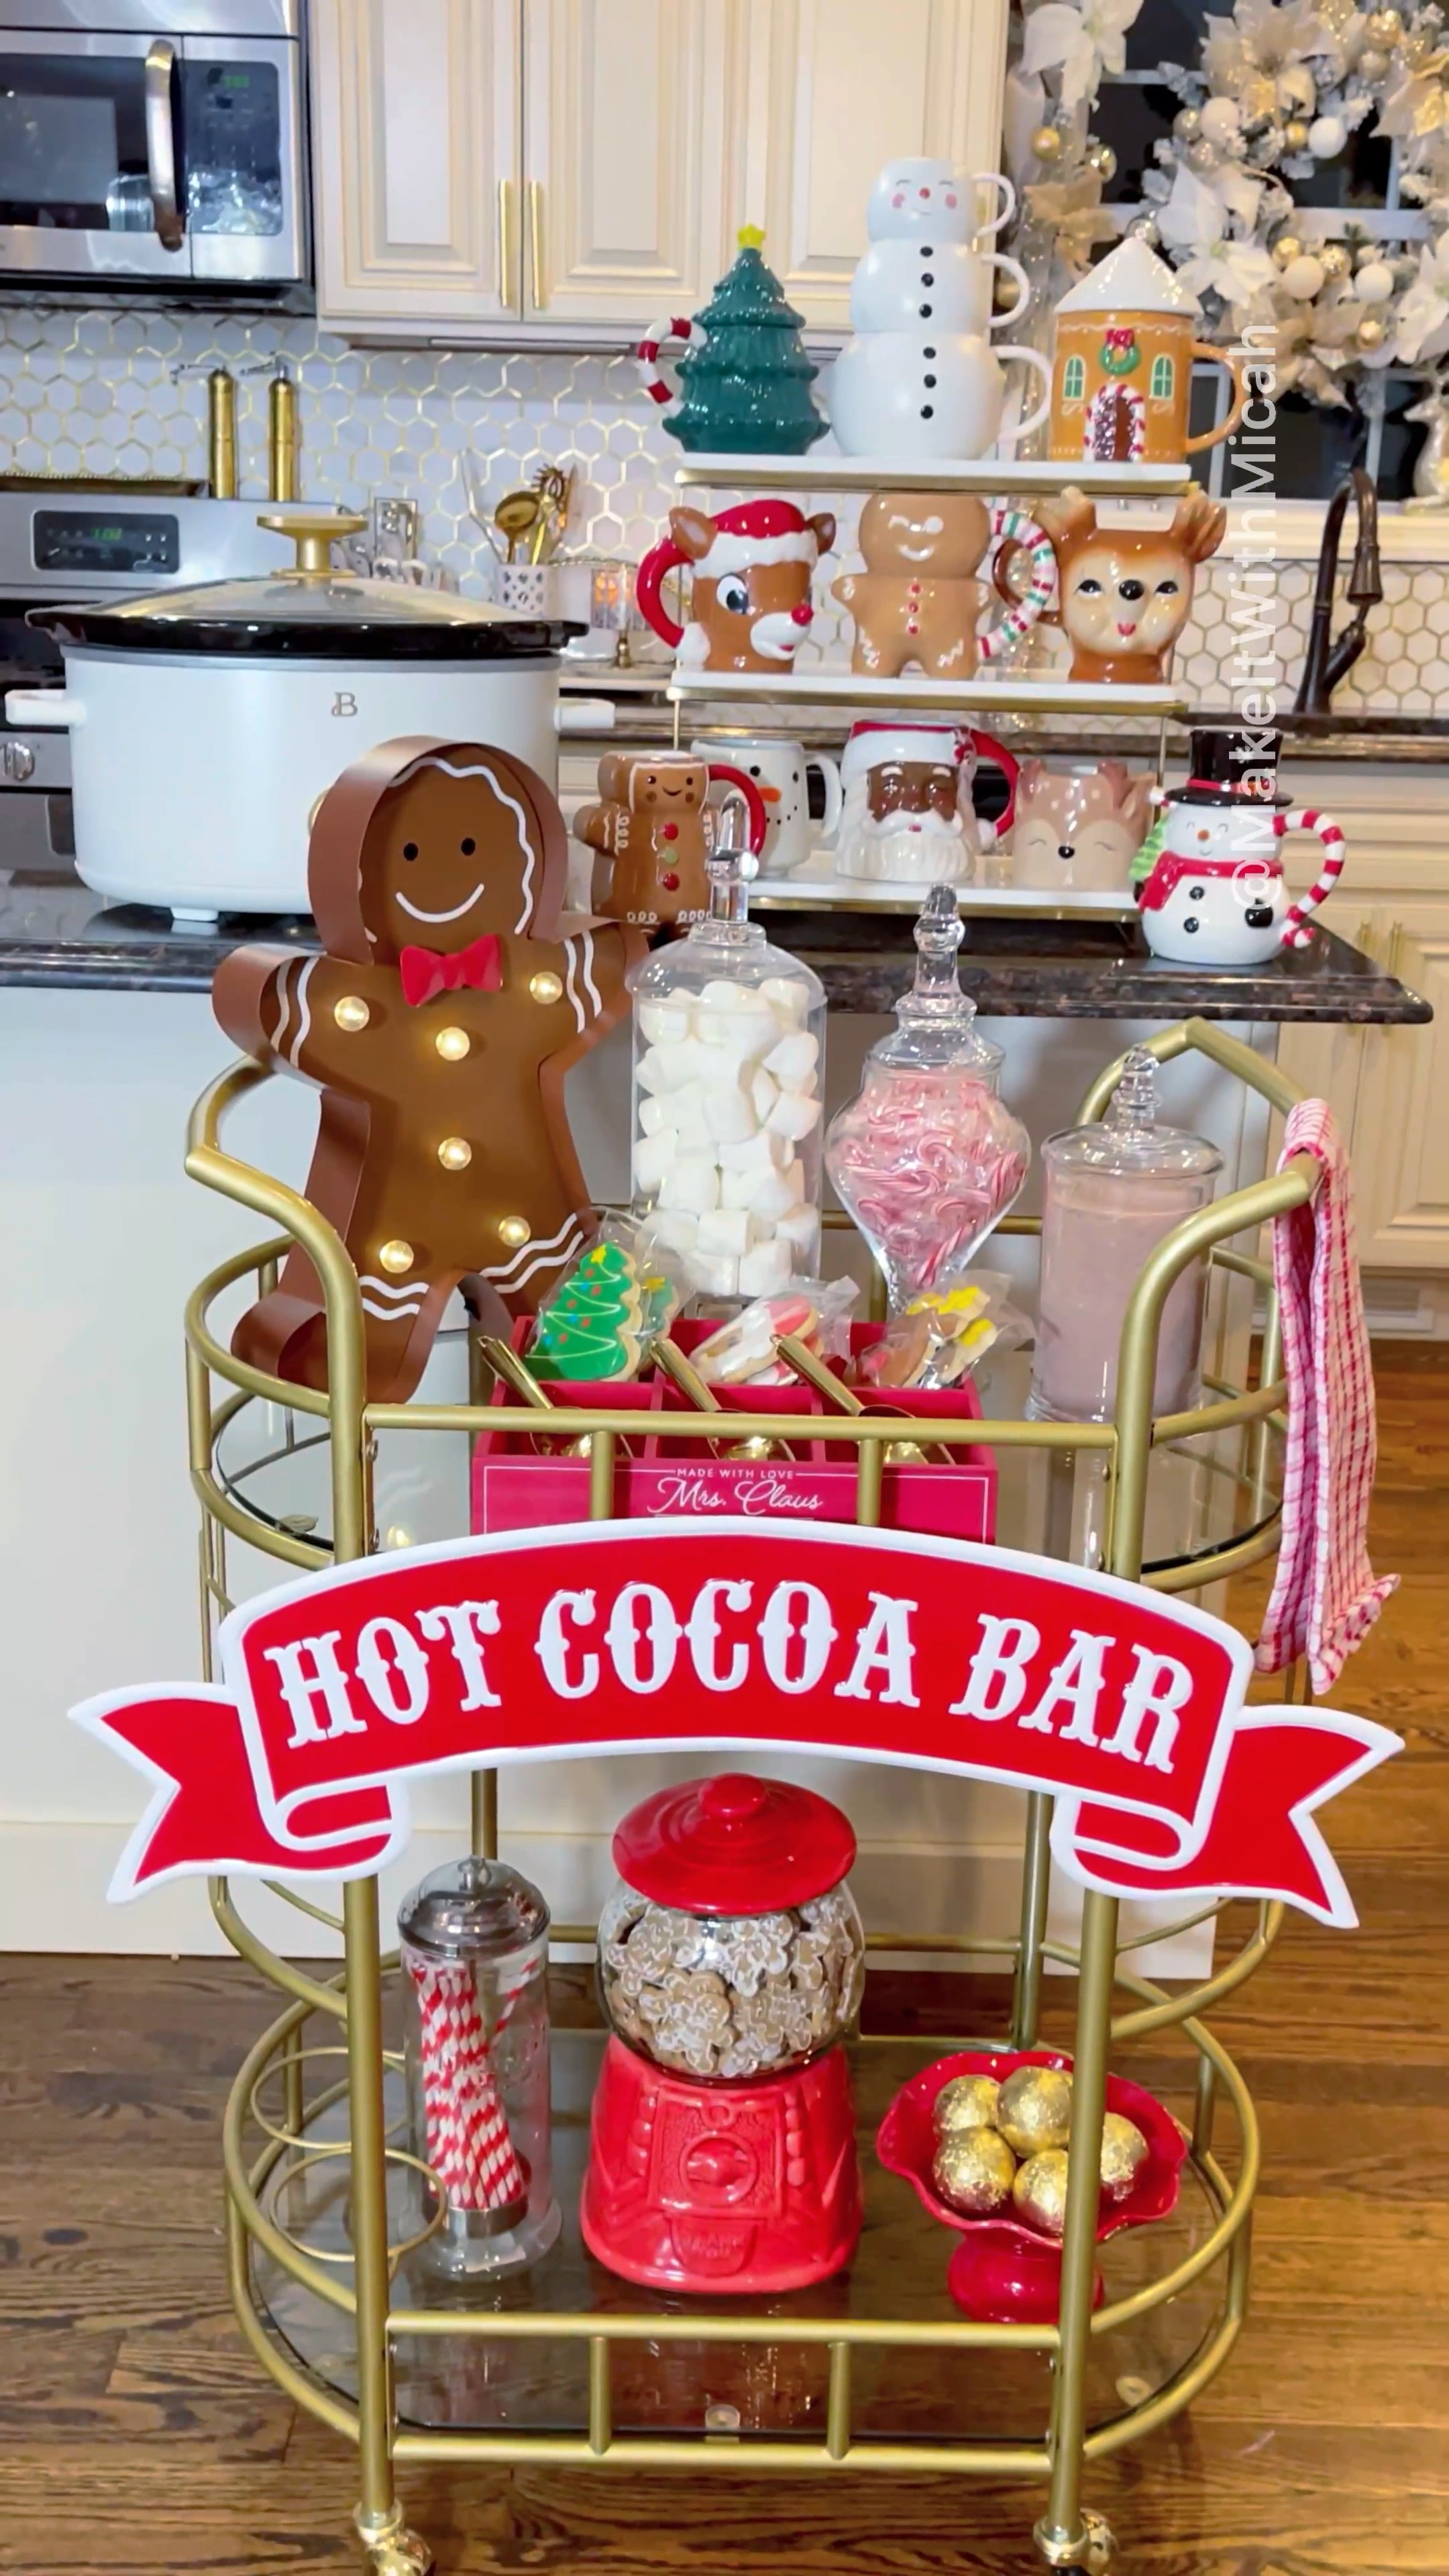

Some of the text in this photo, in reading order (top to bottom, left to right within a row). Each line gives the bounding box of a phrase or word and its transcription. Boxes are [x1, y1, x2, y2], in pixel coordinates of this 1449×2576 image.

[677, 1468, 793, 1480] MADE WITH LOVE
[647, 1477, 824, 1515] Mrs. Claus
[264, 1579, 1192, 1773] HOT COCOA BAR
